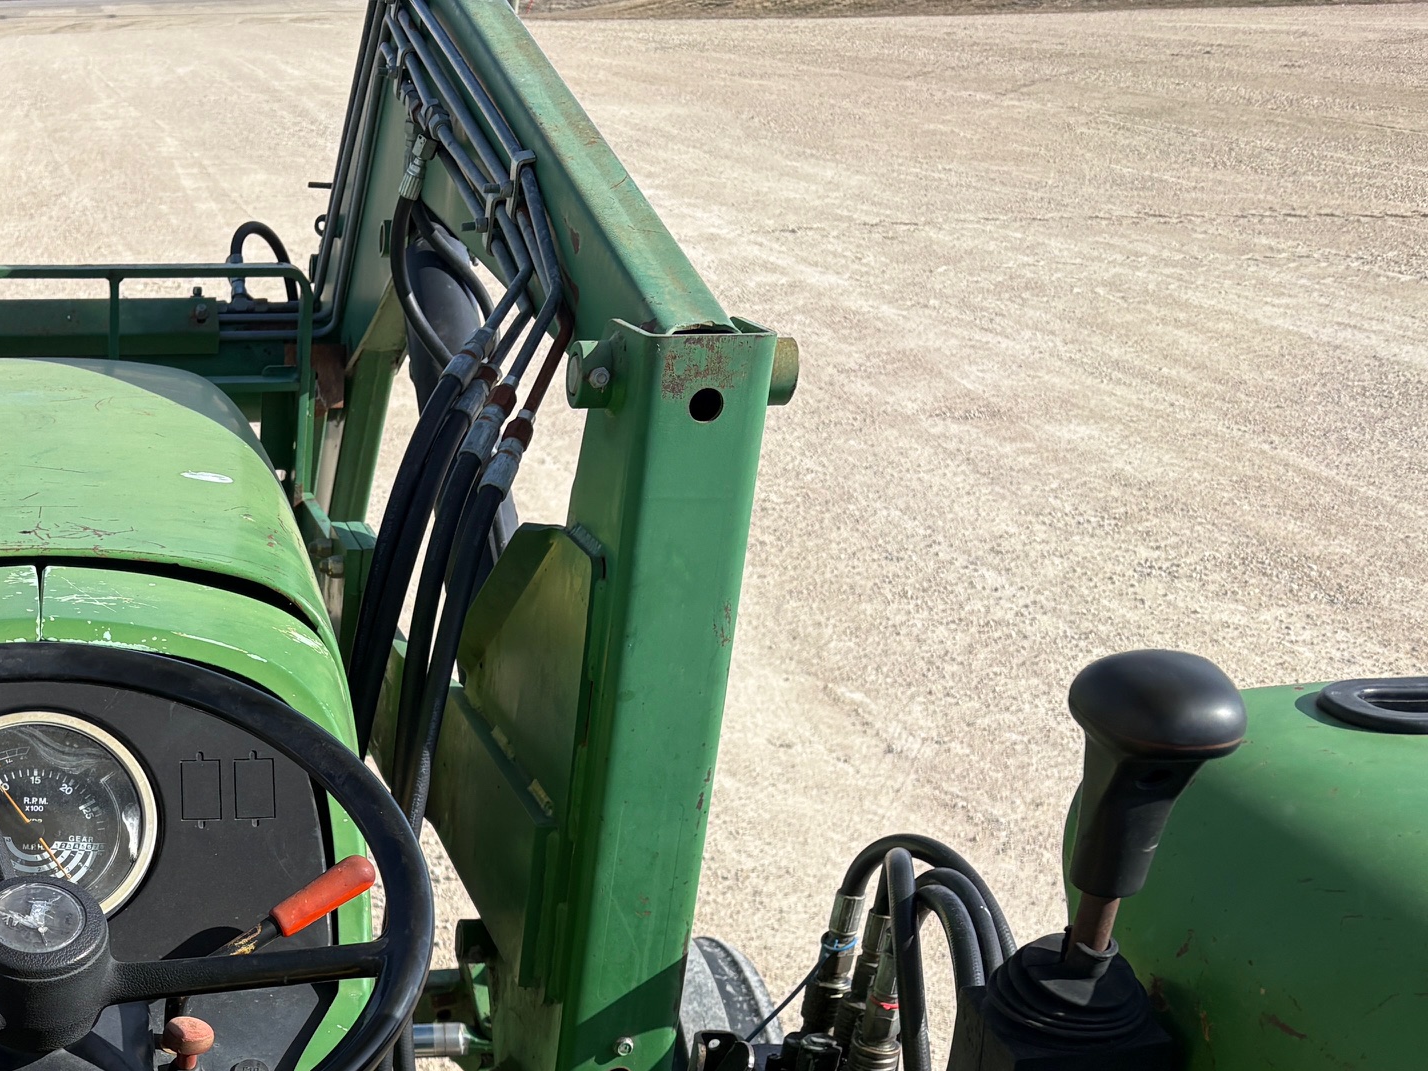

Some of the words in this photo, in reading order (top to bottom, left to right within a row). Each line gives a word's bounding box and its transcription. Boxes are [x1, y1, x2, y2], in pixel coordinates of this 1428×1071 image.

[30, 776, 41, 784] 15
[59, 783, 73, 794] 20
[23, 796, 48, 804] R.P.M.
[83, 807, 94, 819] 25
